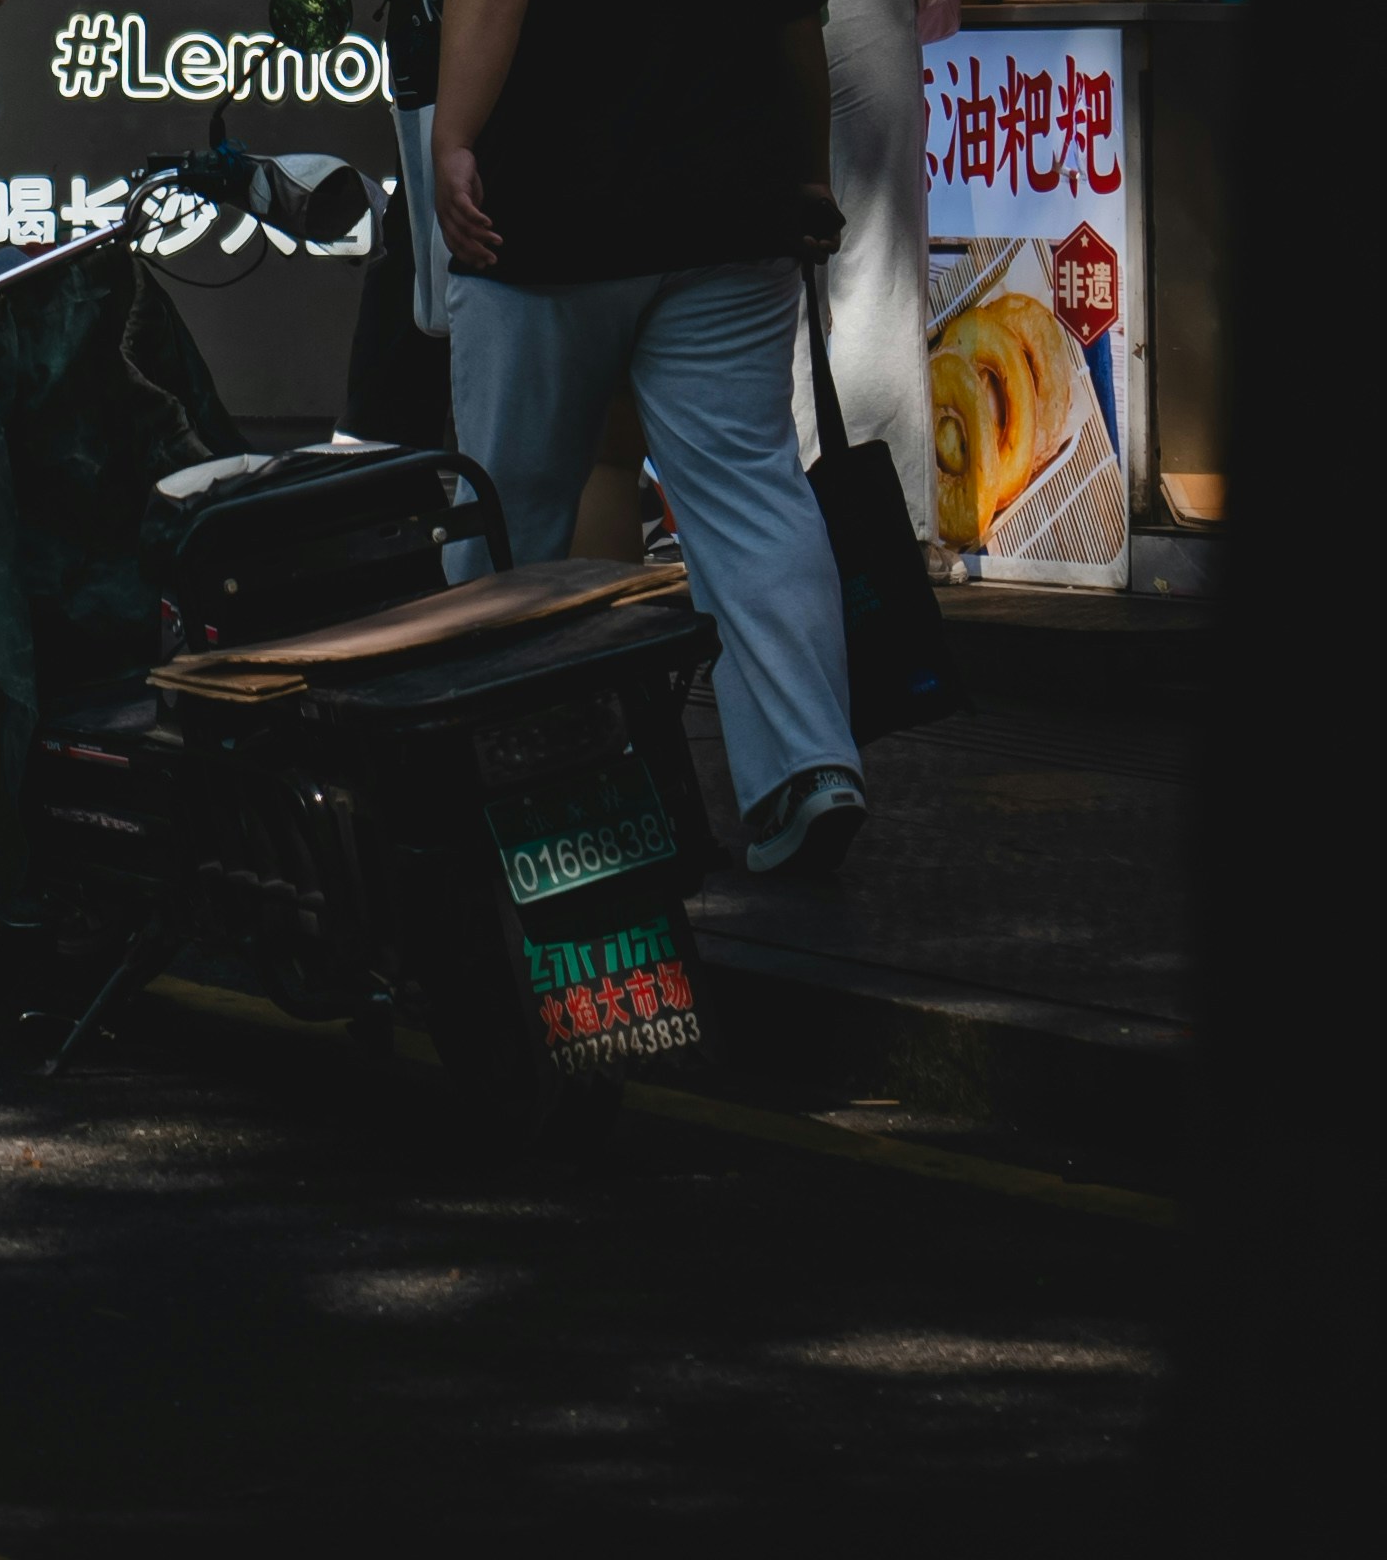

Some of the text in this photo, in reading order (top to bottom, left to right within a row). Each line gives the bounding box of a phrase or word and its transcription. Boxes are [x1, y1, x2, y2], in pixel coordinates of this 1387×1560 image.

[52, 13, 396, 103] #Lemo
[923, 52, 1123, 199] 油粑粑
[1057, 257, 1114, 311] 非遗
[513, 814, 665, 893] 0166838
